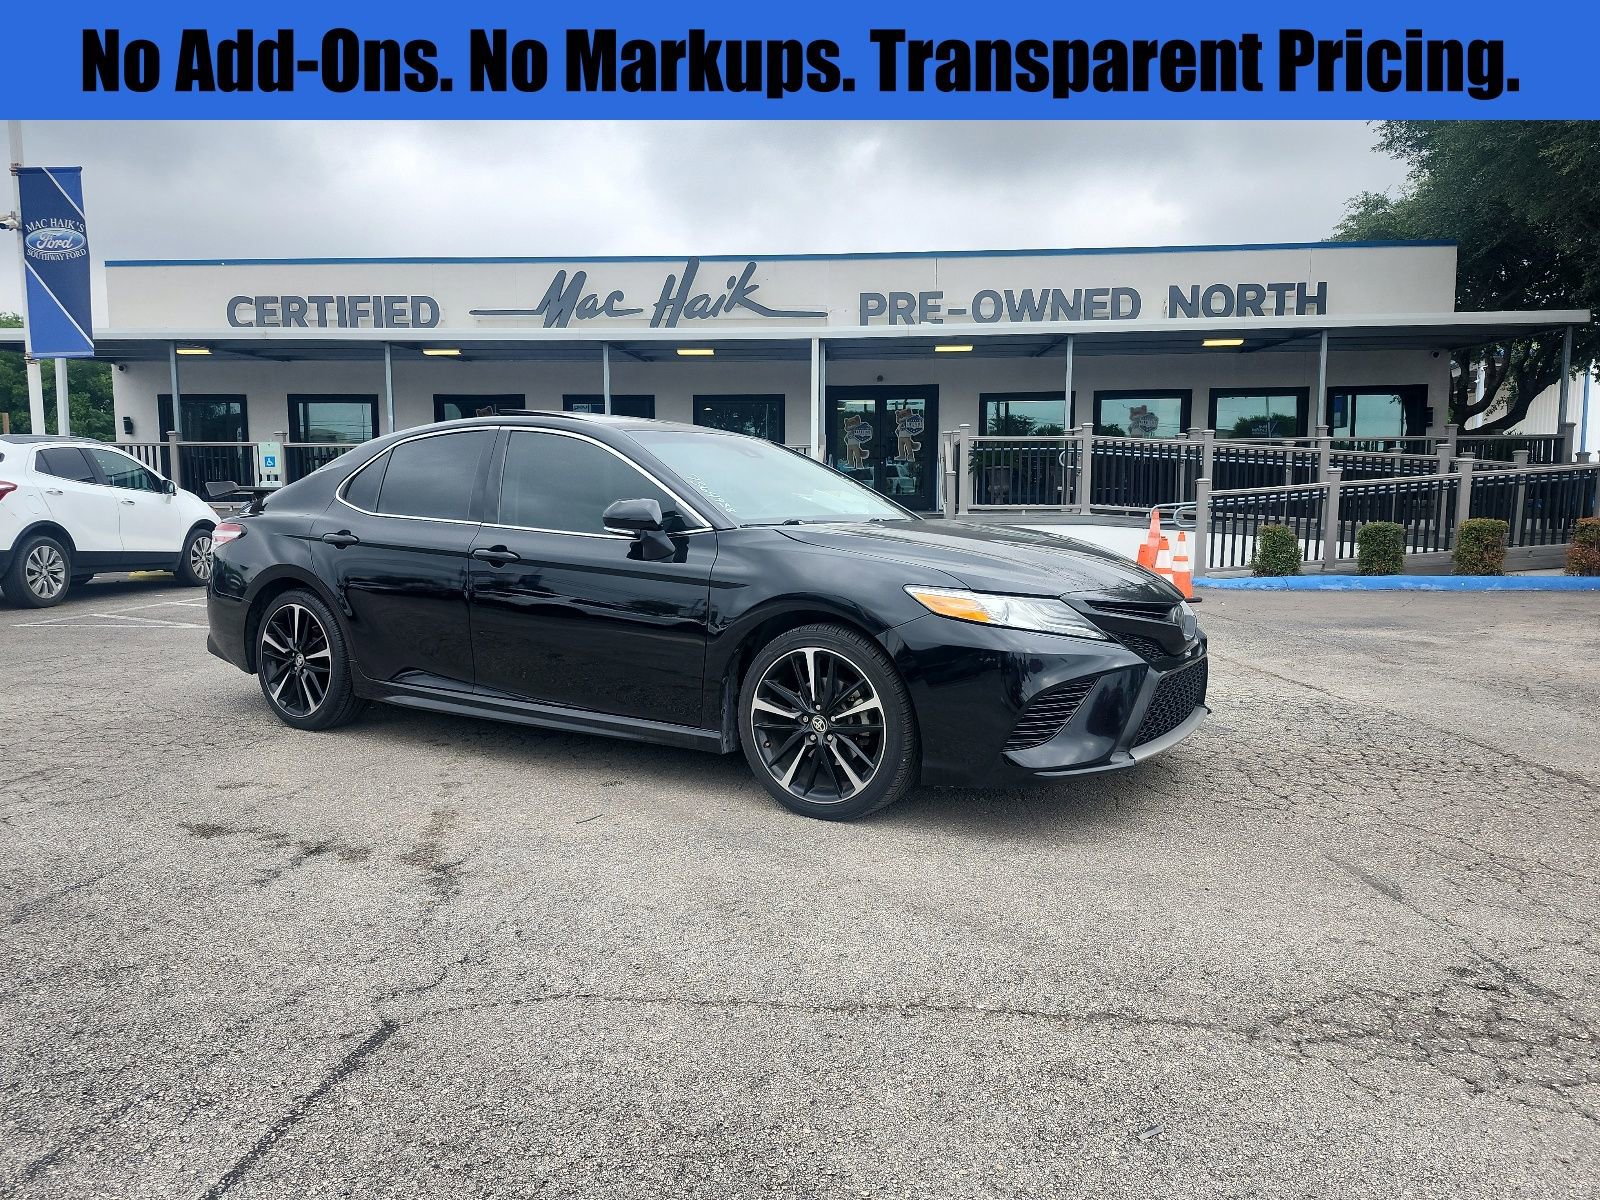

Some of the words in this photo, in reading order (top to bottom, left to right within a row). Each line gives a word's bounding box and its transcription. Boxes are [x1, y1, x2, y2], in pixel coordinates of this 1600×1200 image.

[26, 219, 48, 232] MAC
[36, 232, 73, 249] Ford
[27, 249, 65, 261] SOUTHWAY
[65, 249, 87, 260] FORD
[470, 270, 643, 328] Mac
[649, 257, 828, 328] Haik
[859, 286, 1142, 326] PRE-OWNED
[1168, 281, 1328, 318] NORTH
[226, 295, 440, 328] CERTIFIED
